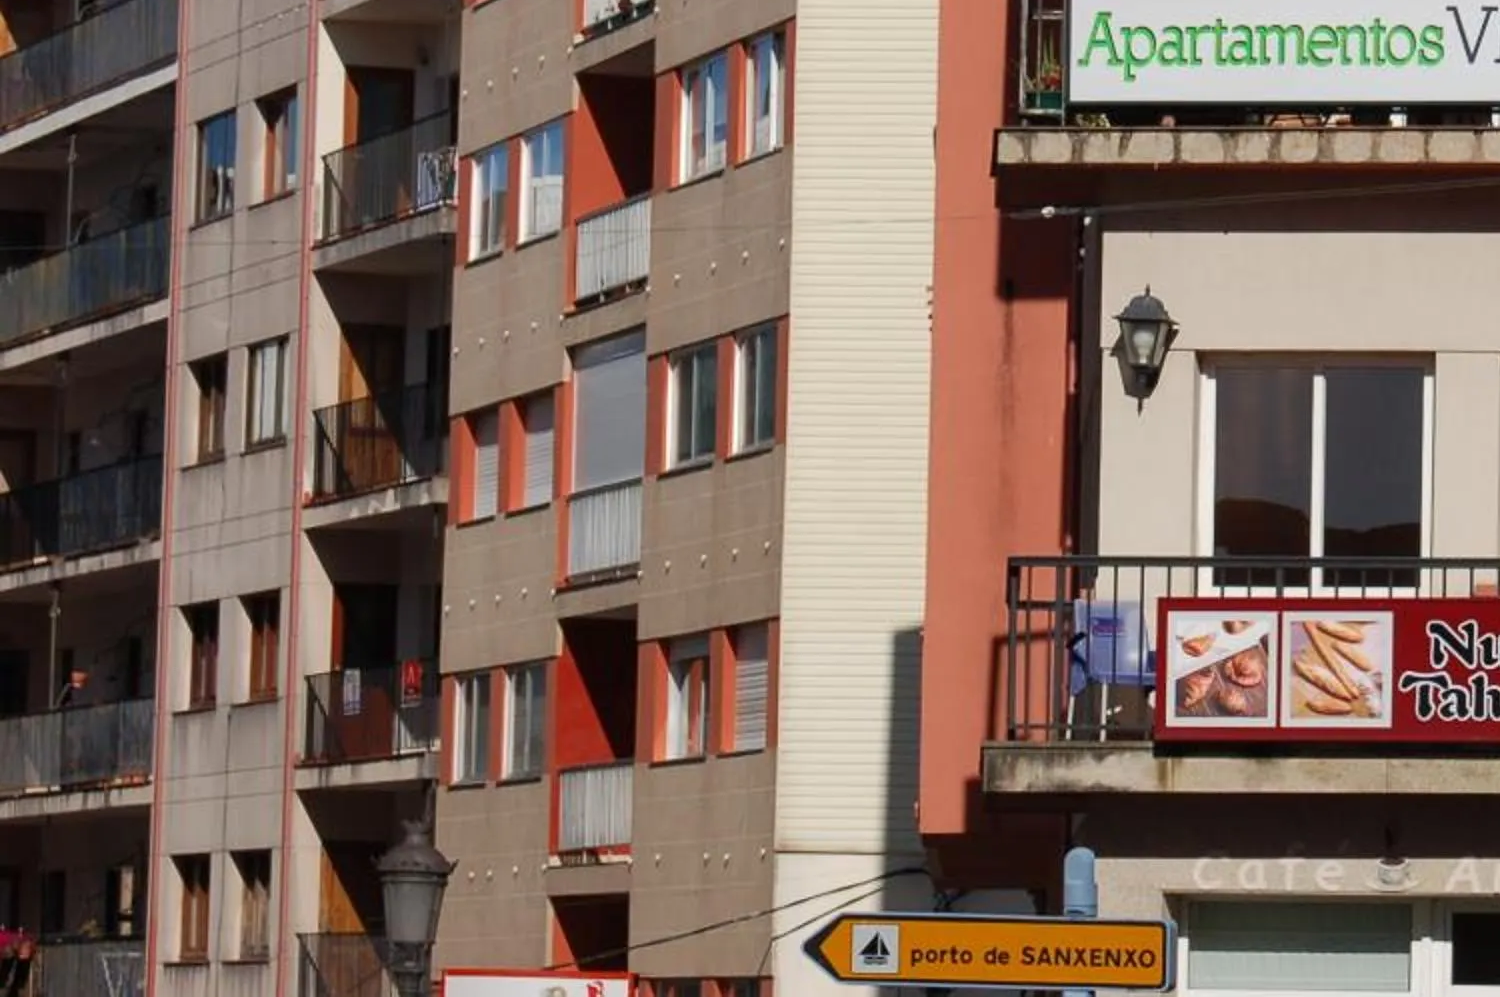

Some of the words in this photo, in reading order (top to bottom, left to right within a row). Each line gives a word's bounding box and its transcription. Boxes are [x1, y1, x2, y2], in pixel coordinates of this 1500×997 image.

[1077, 9, 1444, 81] Apartamentos
[910, 945, 974, 966] porto
[984, 946, 1010, 965] de
[1020, 946, 1157, 969] SANXENXO
